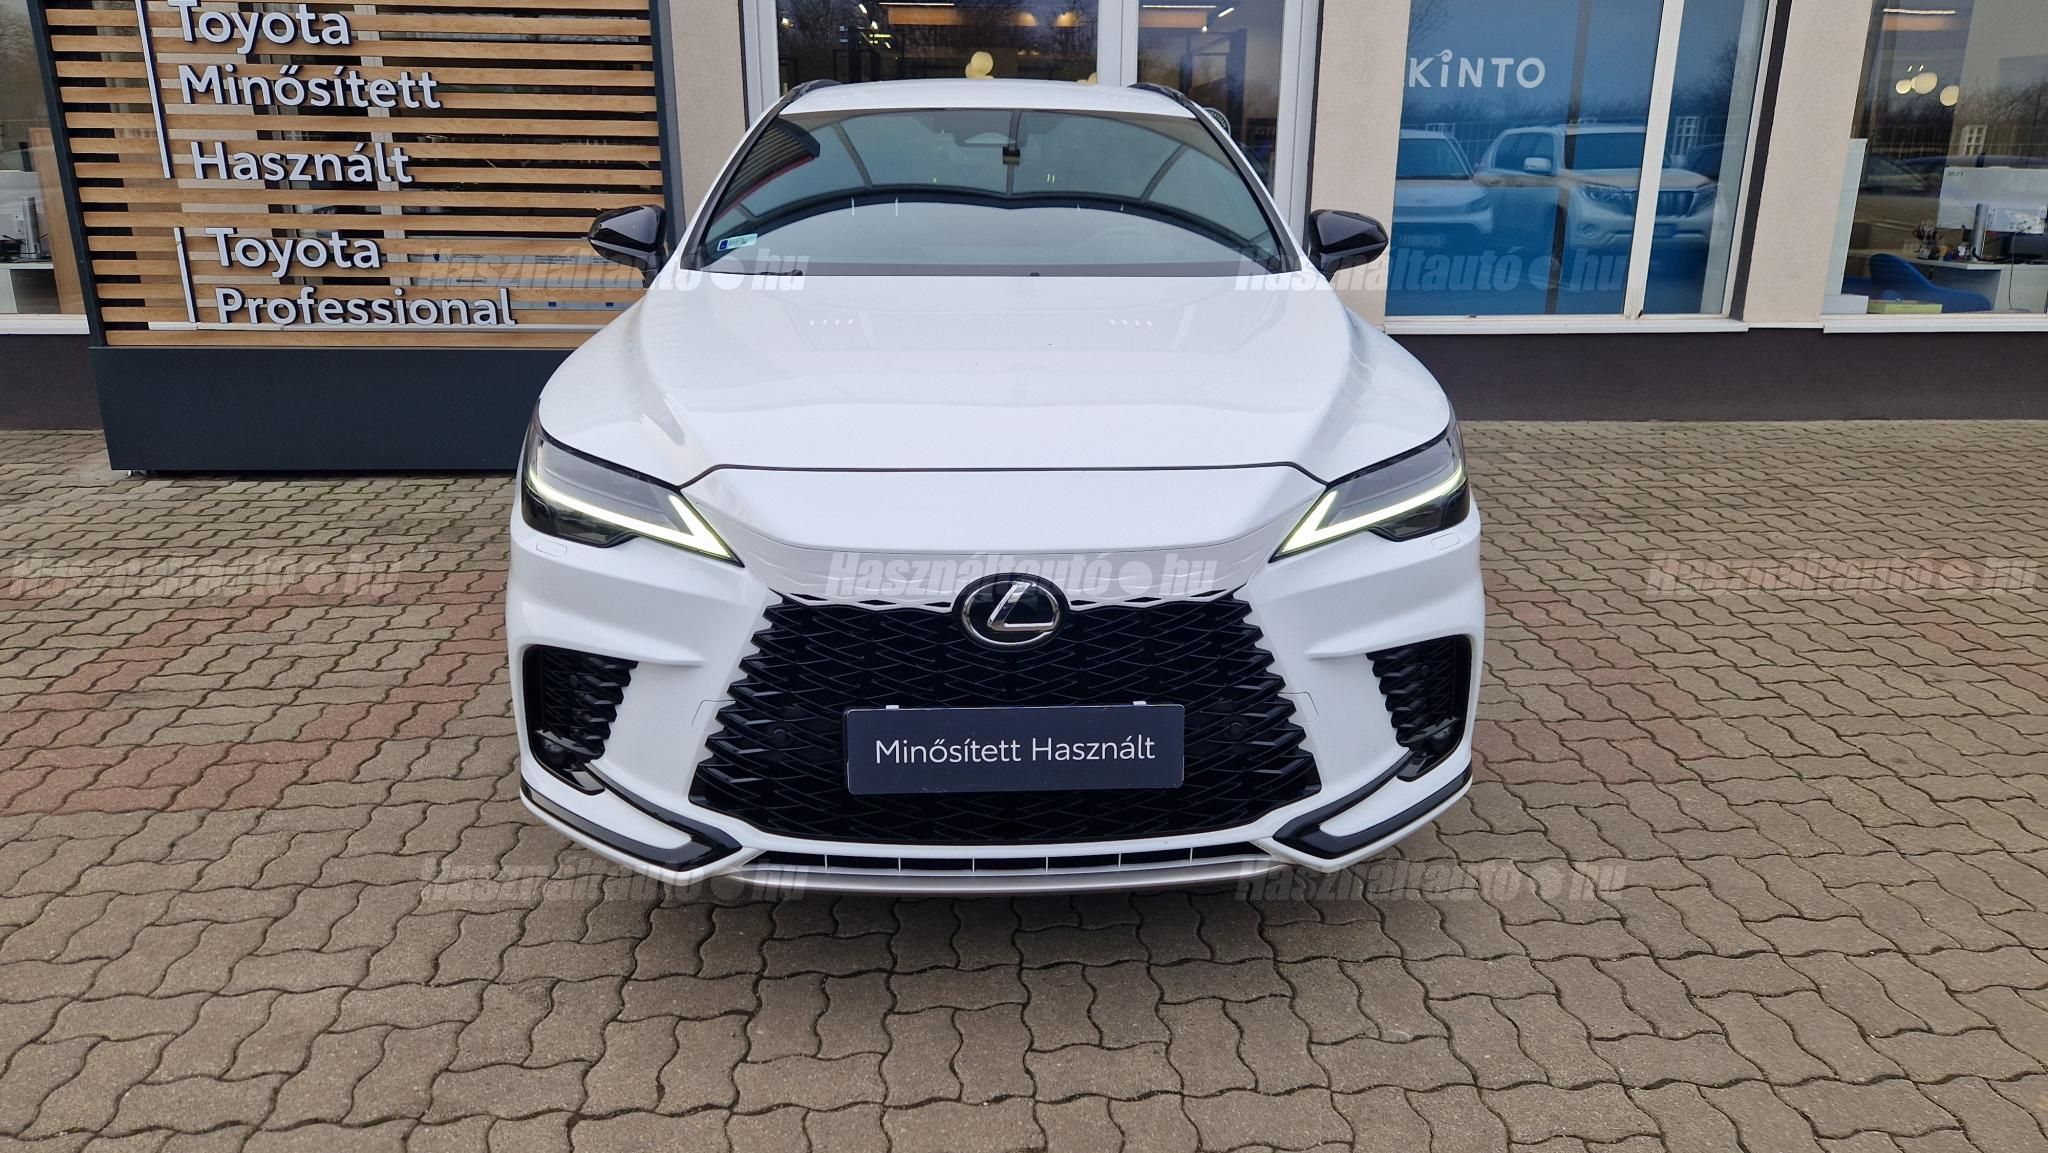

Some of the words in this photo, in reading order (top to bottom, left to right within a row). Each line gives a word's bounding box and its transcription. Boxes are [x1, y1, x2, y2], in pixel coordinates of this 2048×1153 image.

[173, 0, 353, 55] Toyota
[178, 64, 442, 109] Minősített
[191, 141, 413, 184] Használt
[204, 227, 381, 278] Toyota
[215, 287, 516, 326] Professional
[874, 736, 1021, 766] Minősített
[1032, 734, 1156, 764] Használt
